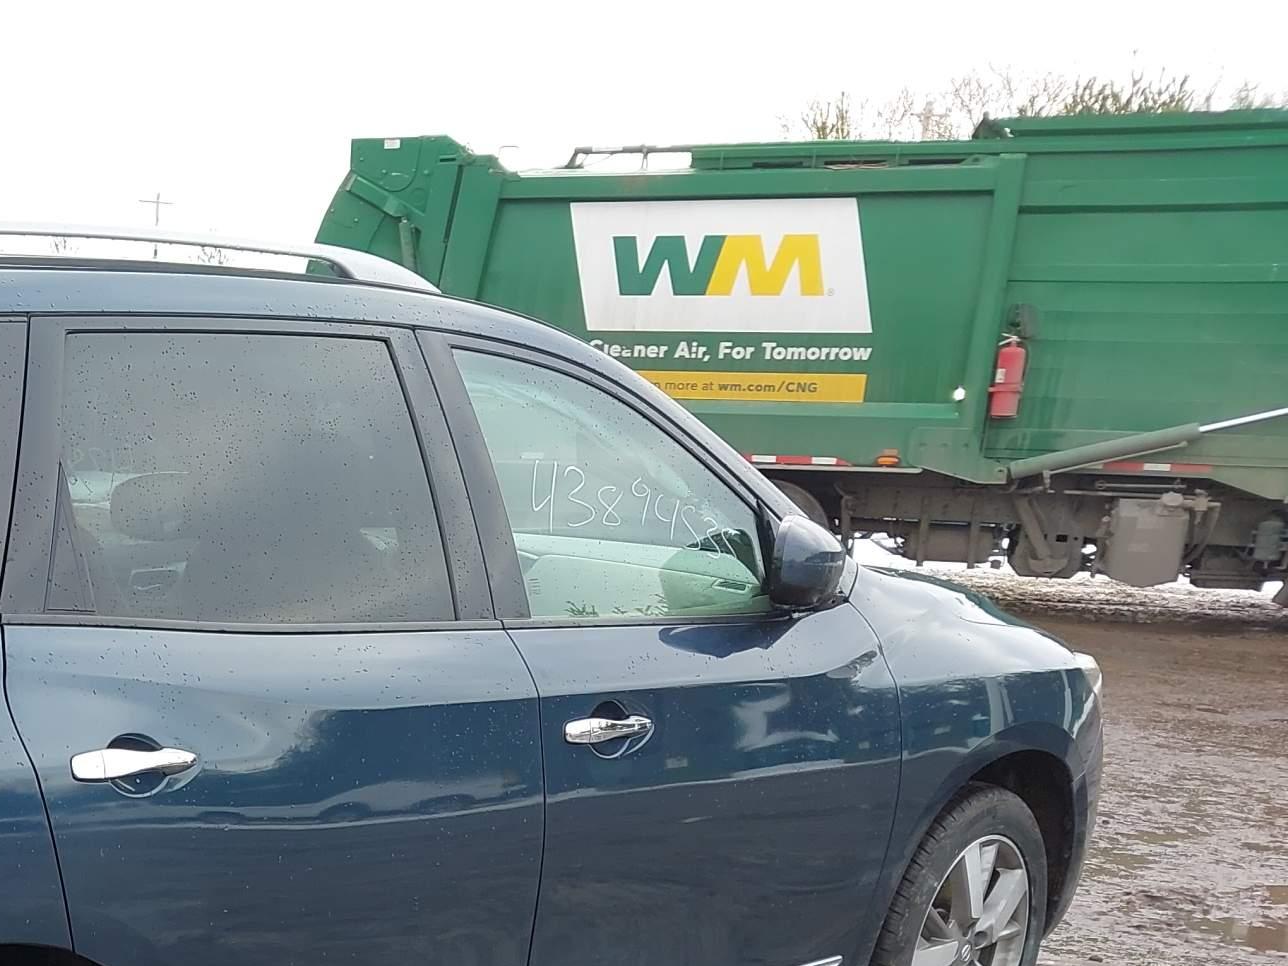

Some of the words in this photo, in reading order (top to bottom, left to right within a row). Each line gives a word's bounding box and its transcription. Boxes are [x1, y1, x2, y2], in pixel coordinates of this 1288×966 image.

[612, 234, 825, 296] WM
[673, 341, 711, 361] Air,
[718, 342, 755, 360] For
[762, 342, 872, 361] Tomorrow
[664, 382, 697, 391] more
[701, 381, 714, 391] at
[718, 381, 818, 394] wm.com/CNG
